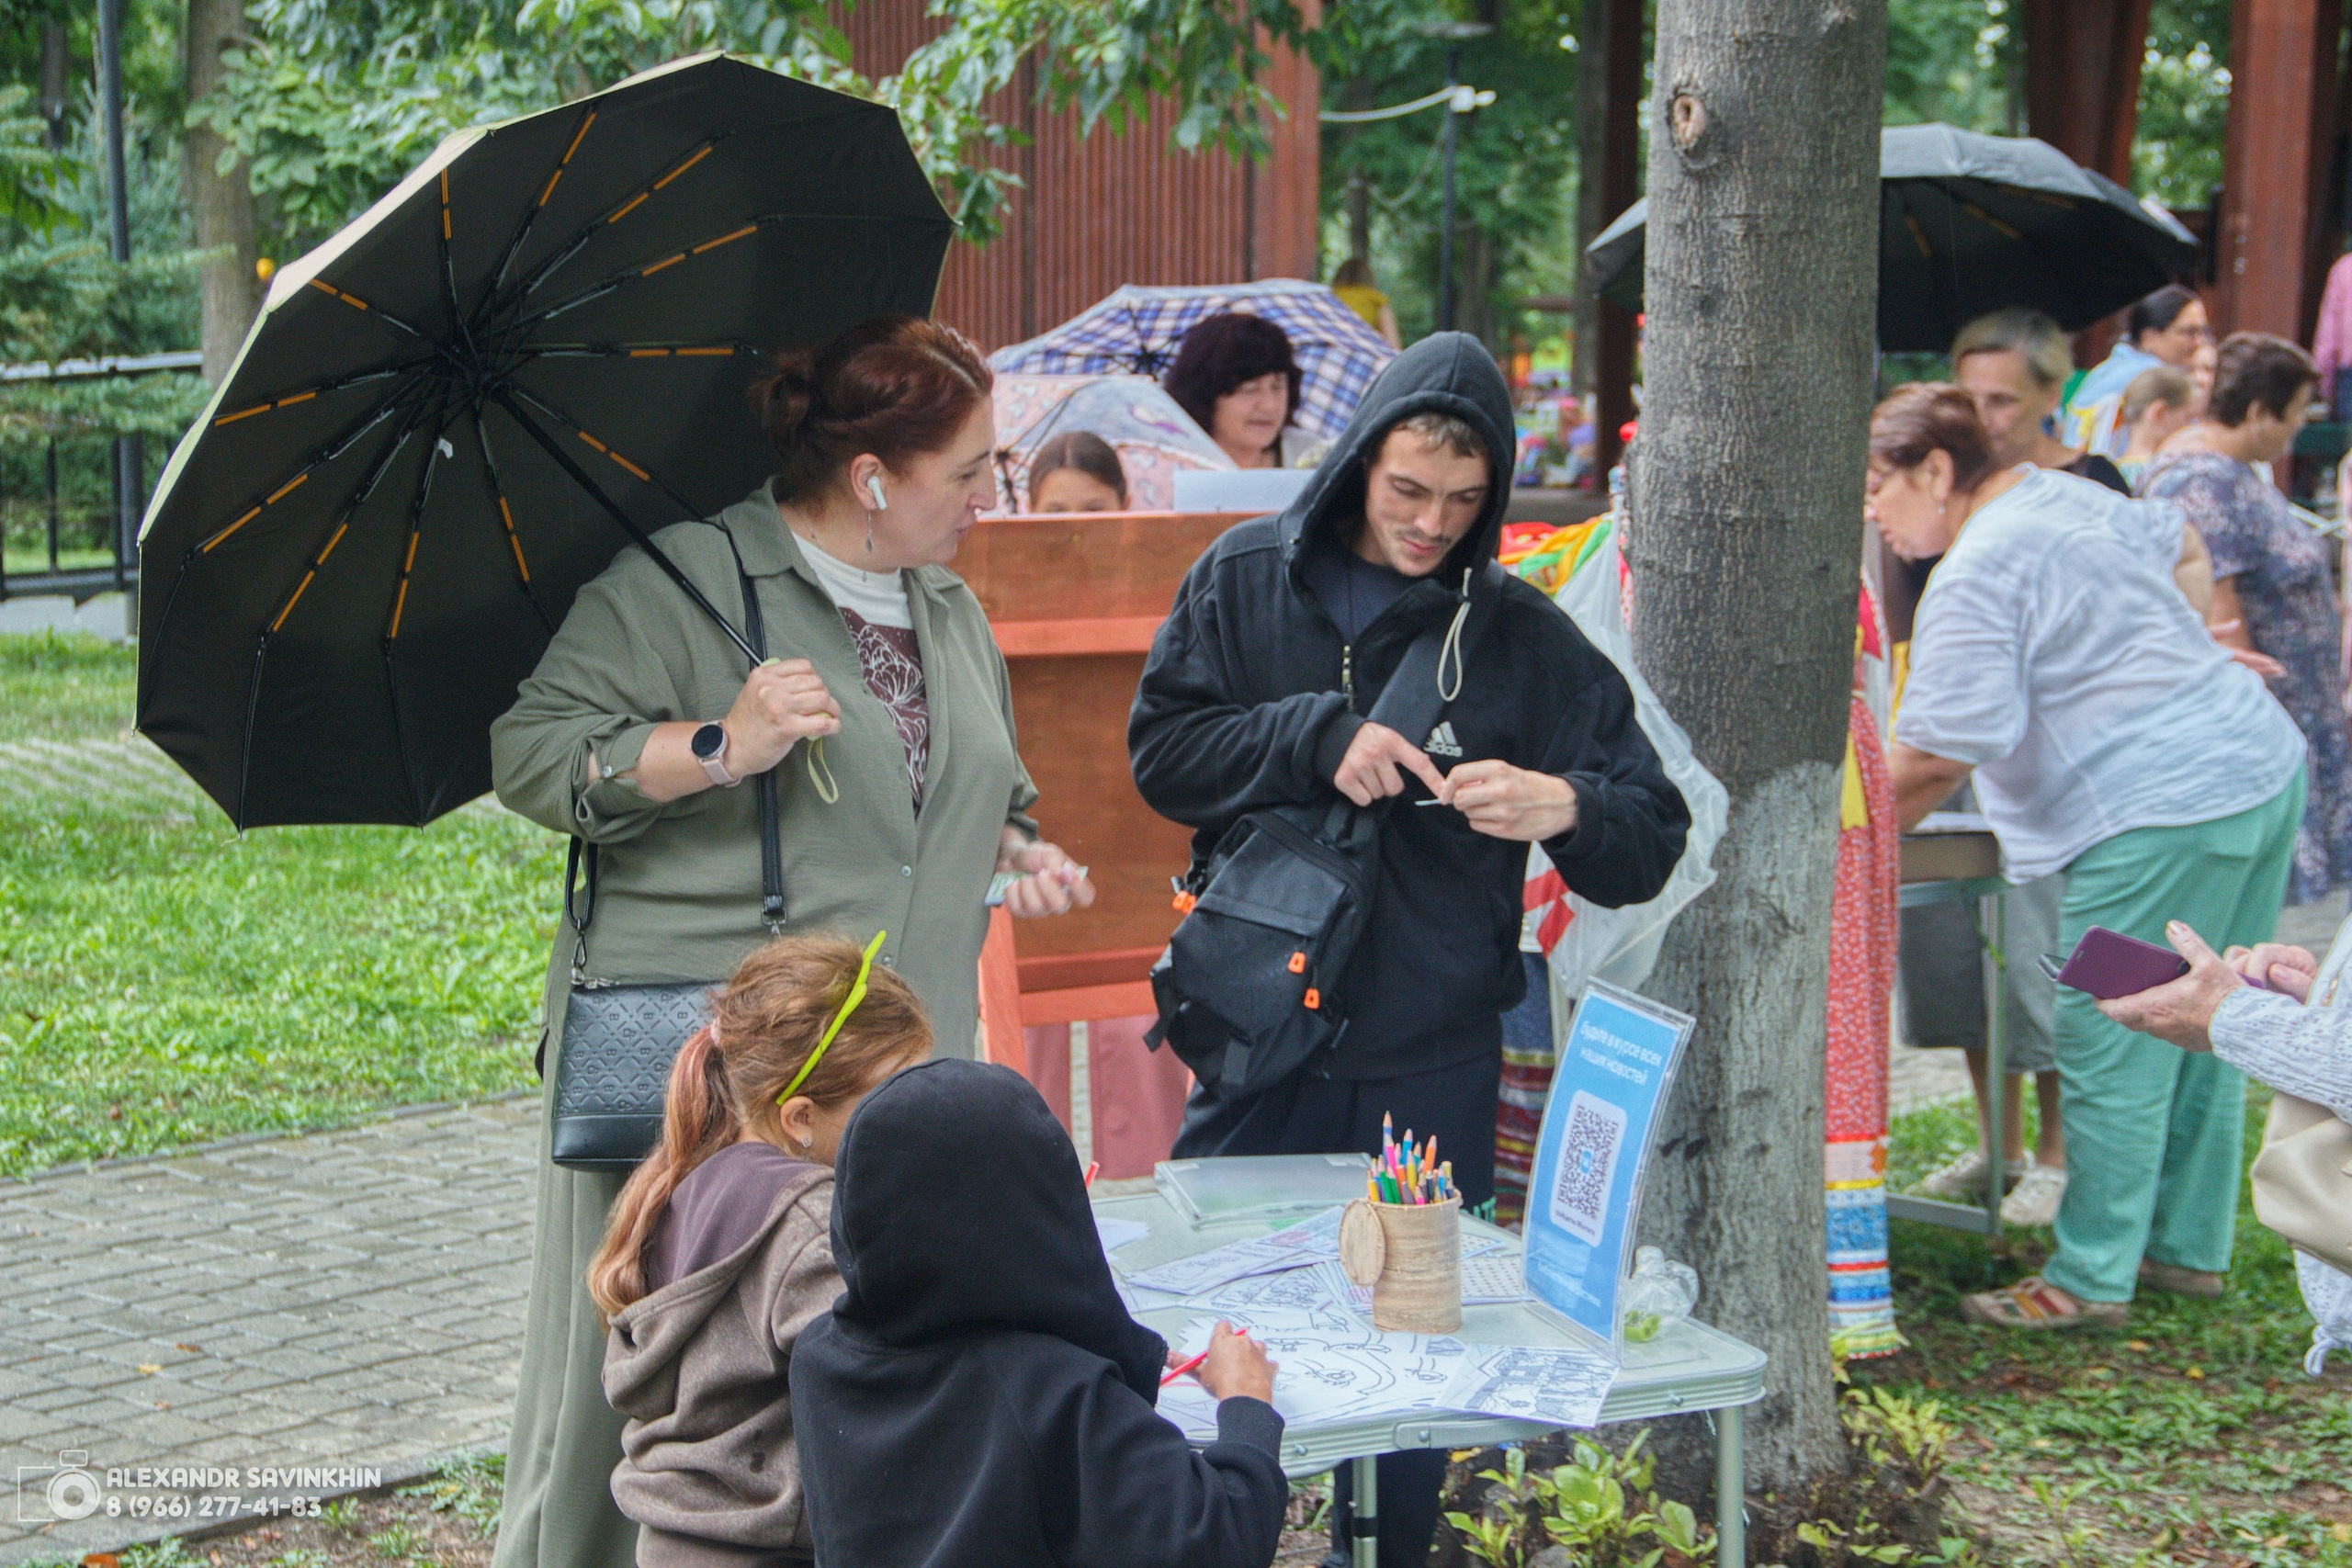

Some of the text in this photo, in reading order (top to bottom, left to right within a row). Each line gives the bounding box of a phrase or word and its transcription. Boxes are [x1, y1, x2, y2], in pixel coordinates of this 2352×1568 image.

[1614, 1036, 1641, 1058] курсе
[1640, 1048, 1663, 1066] всех
[1606, 1058, 1649, 1086] новостей
